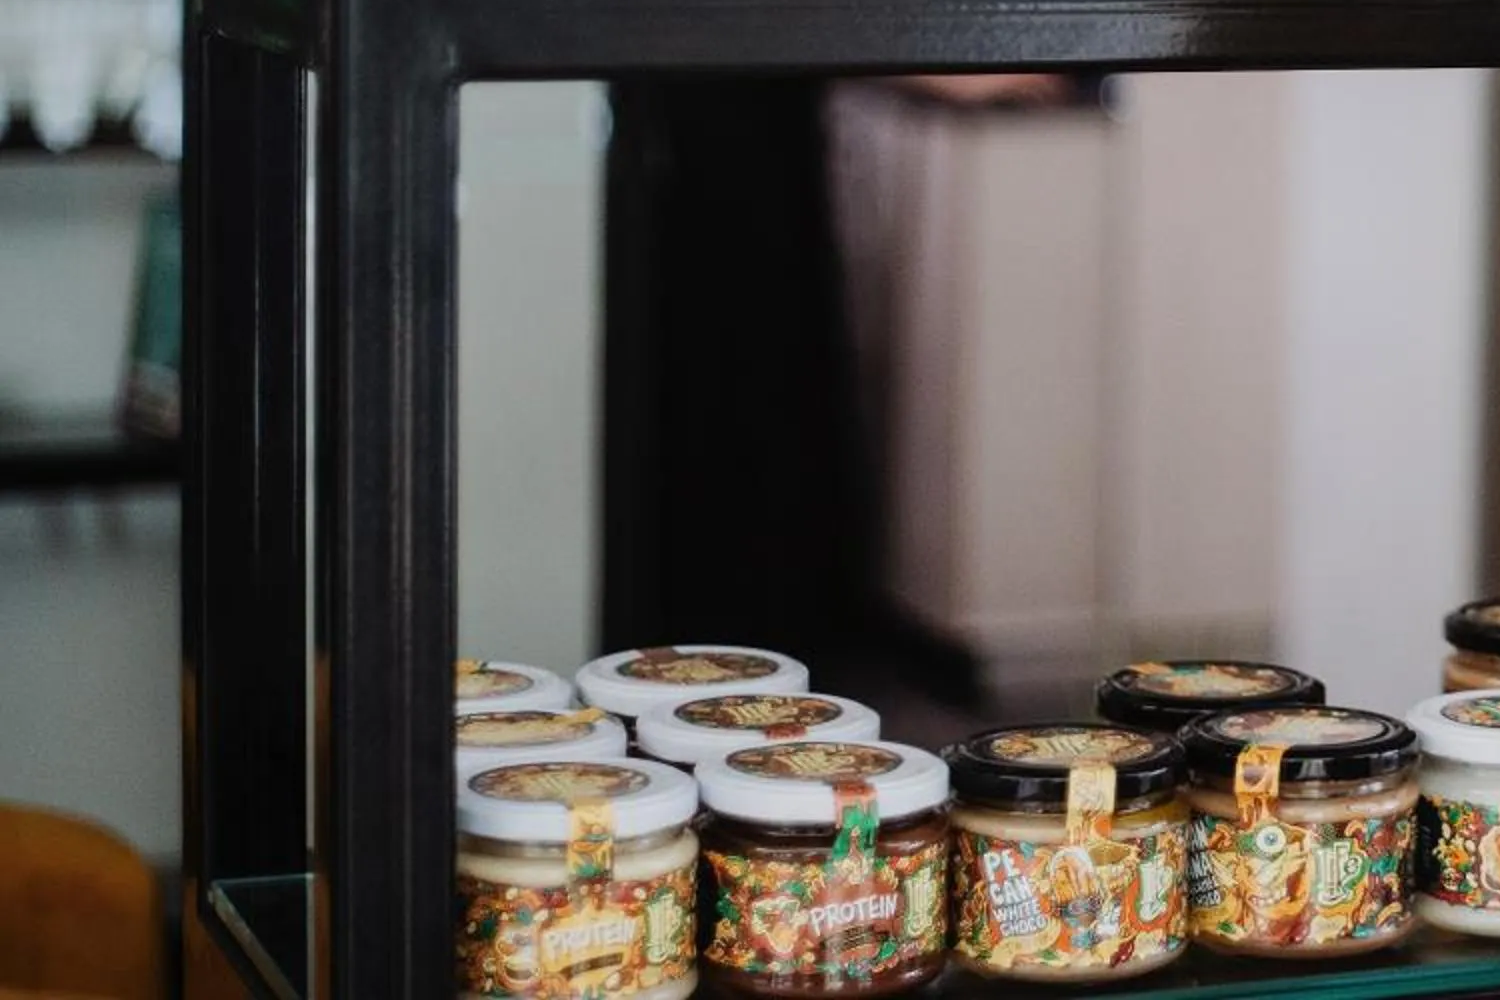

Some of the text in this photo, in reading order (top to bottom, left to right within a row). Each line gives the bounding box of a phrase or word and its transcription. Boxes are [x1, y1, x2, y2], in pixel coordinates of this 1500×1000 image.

[982, 848, 1020, 882] PE
[989, 875, 1033, 906] CAN
[810, 892, 899, 937] PROTEIN
[992, 899, 1042, 923] WHITE
[542, 914, 637, 961] PROTEIN
